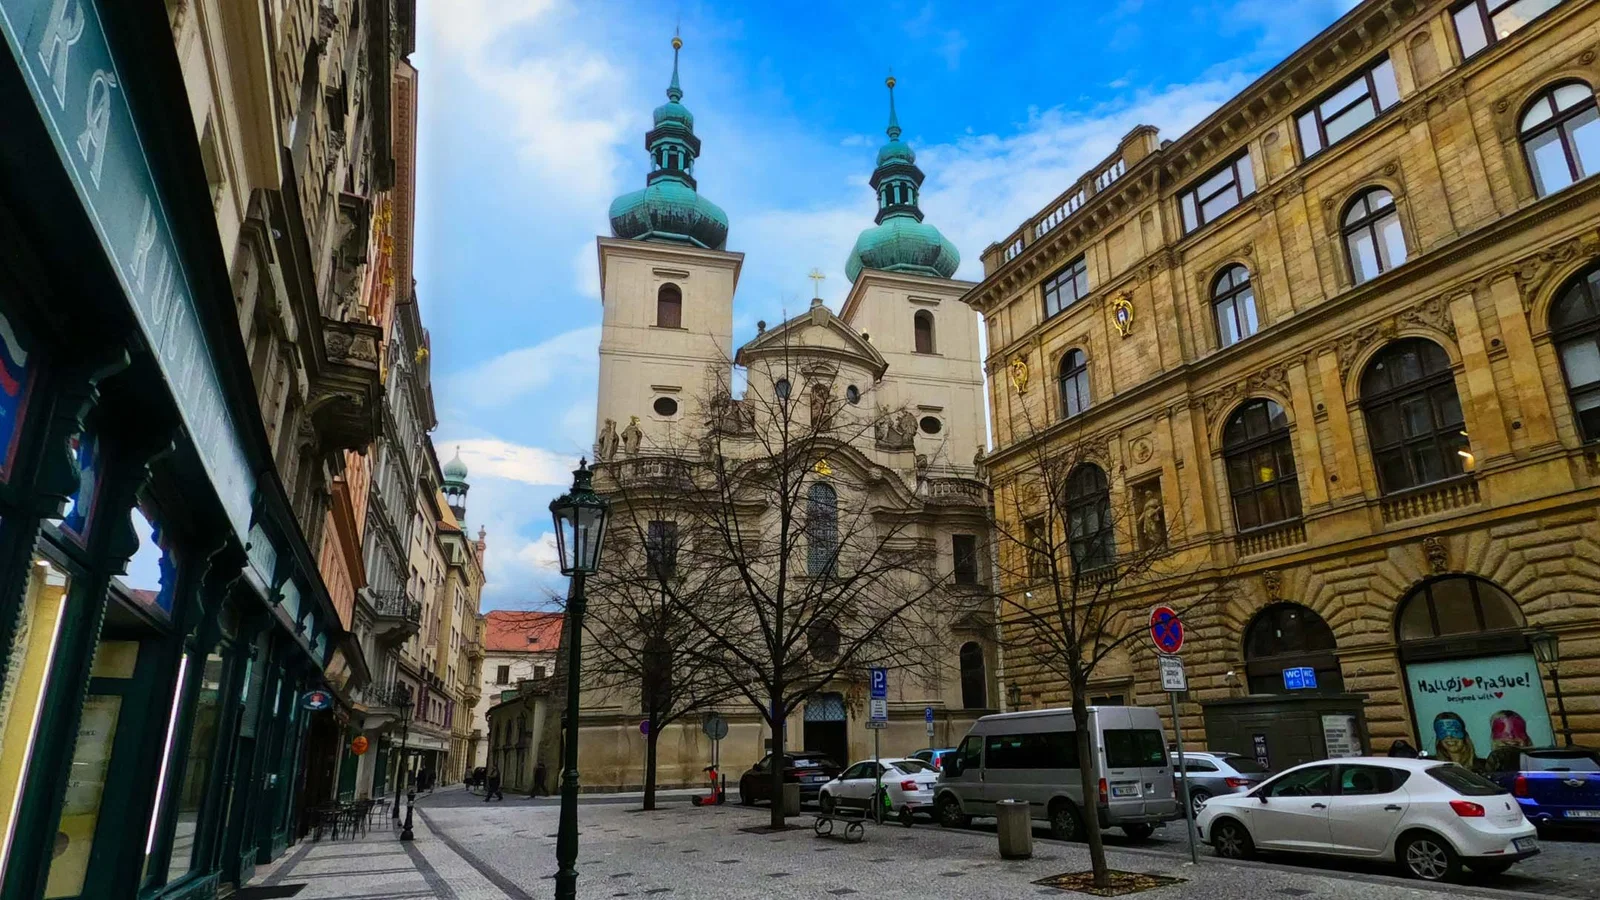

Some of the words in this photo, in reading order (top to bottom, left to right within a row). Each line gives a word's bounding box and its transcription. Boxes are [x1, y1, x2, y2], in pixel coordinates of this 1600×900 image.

[1286, 670, 1300, 678] WC
[1303, 669, 1313, 677] WC
[874, 671, 884, 688] P
[1475, 672, 1530, 690] Prague!
